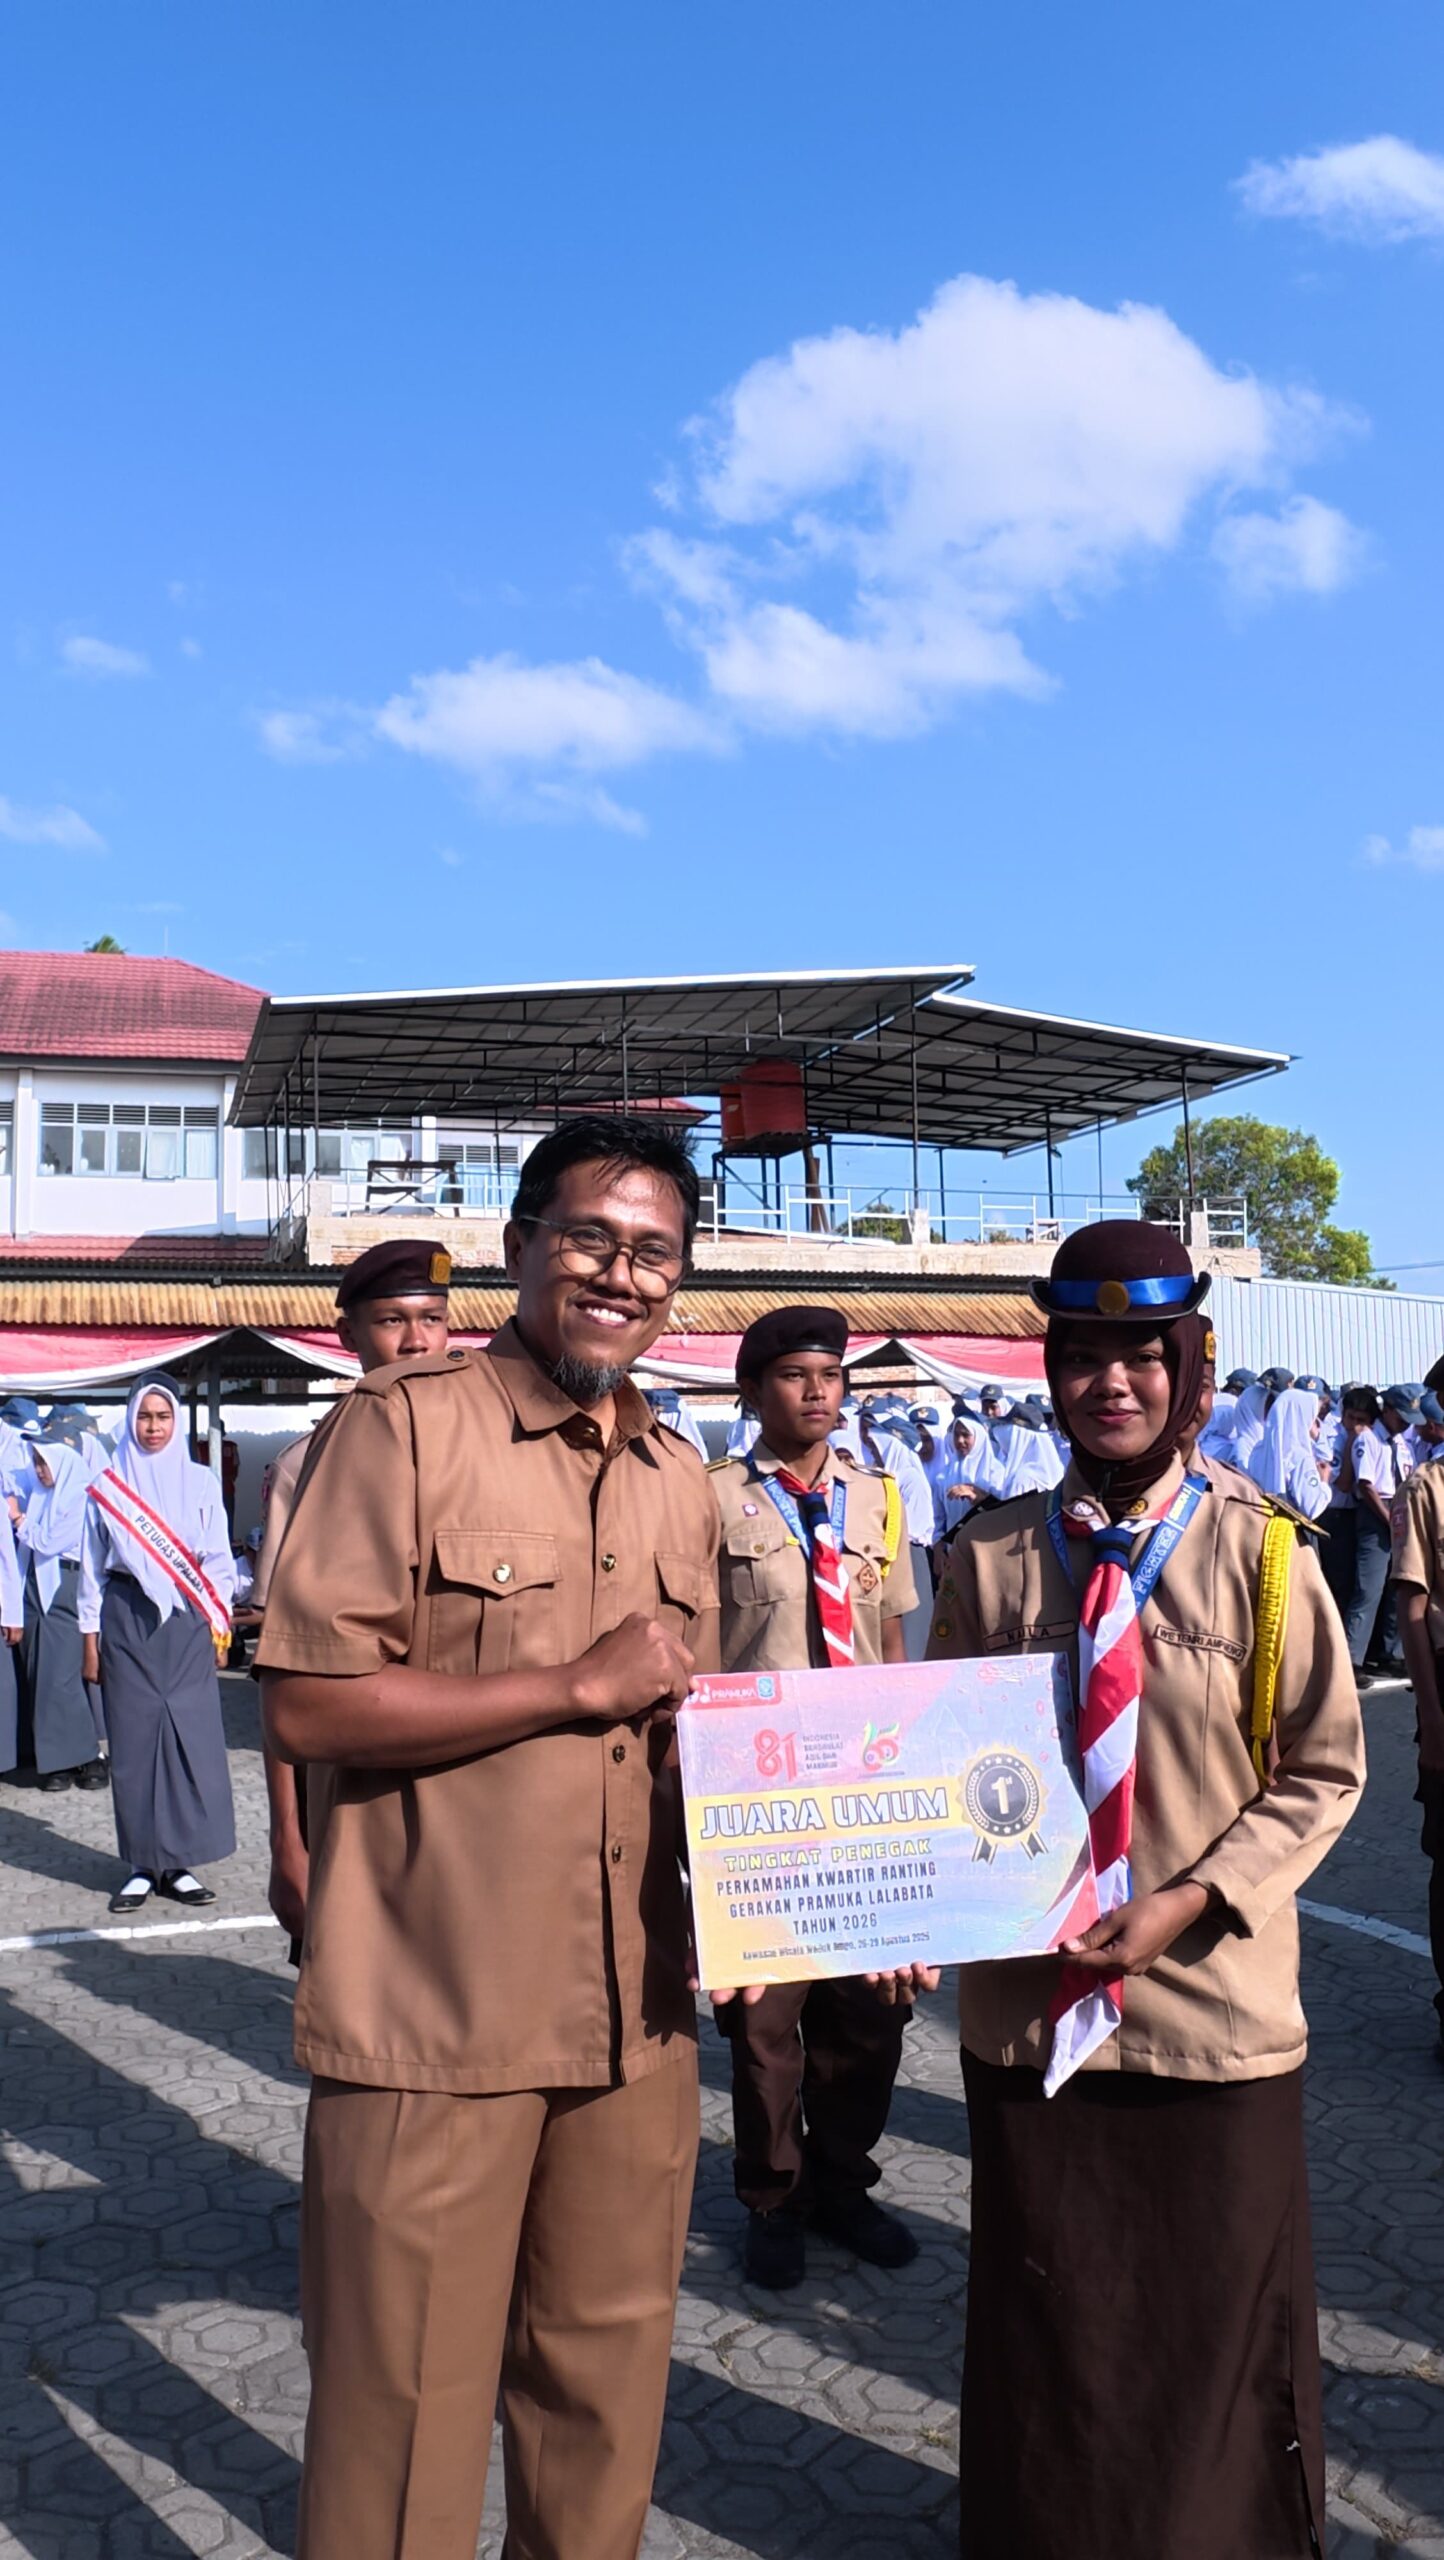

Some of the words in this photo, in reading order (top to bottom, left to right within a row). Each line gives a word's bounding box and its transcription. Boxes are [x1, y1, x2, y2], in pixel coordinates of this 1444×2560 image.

[135, 1515, 175, 1558] PETUGAS
[1132, 1526, 1178, 1595] FIGHTER
[712, 1688, 756, 1698] PRAMUKA
[754, 1728, 797, 1781] 81
[701, 1798, 826, 1839] JUARA
[831, 1787, 949, 1828] UMUM
[724, 1849, 822, 1872] TINGKAT
[831, 1838, 932, 1863] PENEGAK
[716, 1873, 810, 1897] PERKAMAHAN
[816, 1867, 875, 1888] KWARTIR
[881, 1861, 937, 1881] RANTING
[729, 1900, 792, 1918] GERAKAN
[798, 1893, 863, 1911] PRAMUKA
[868, 1884, 934, 1905] LALABATA
[793, 1919, 836, 1936] TAHUN
[842, 1912, 878, 1931] 2026
